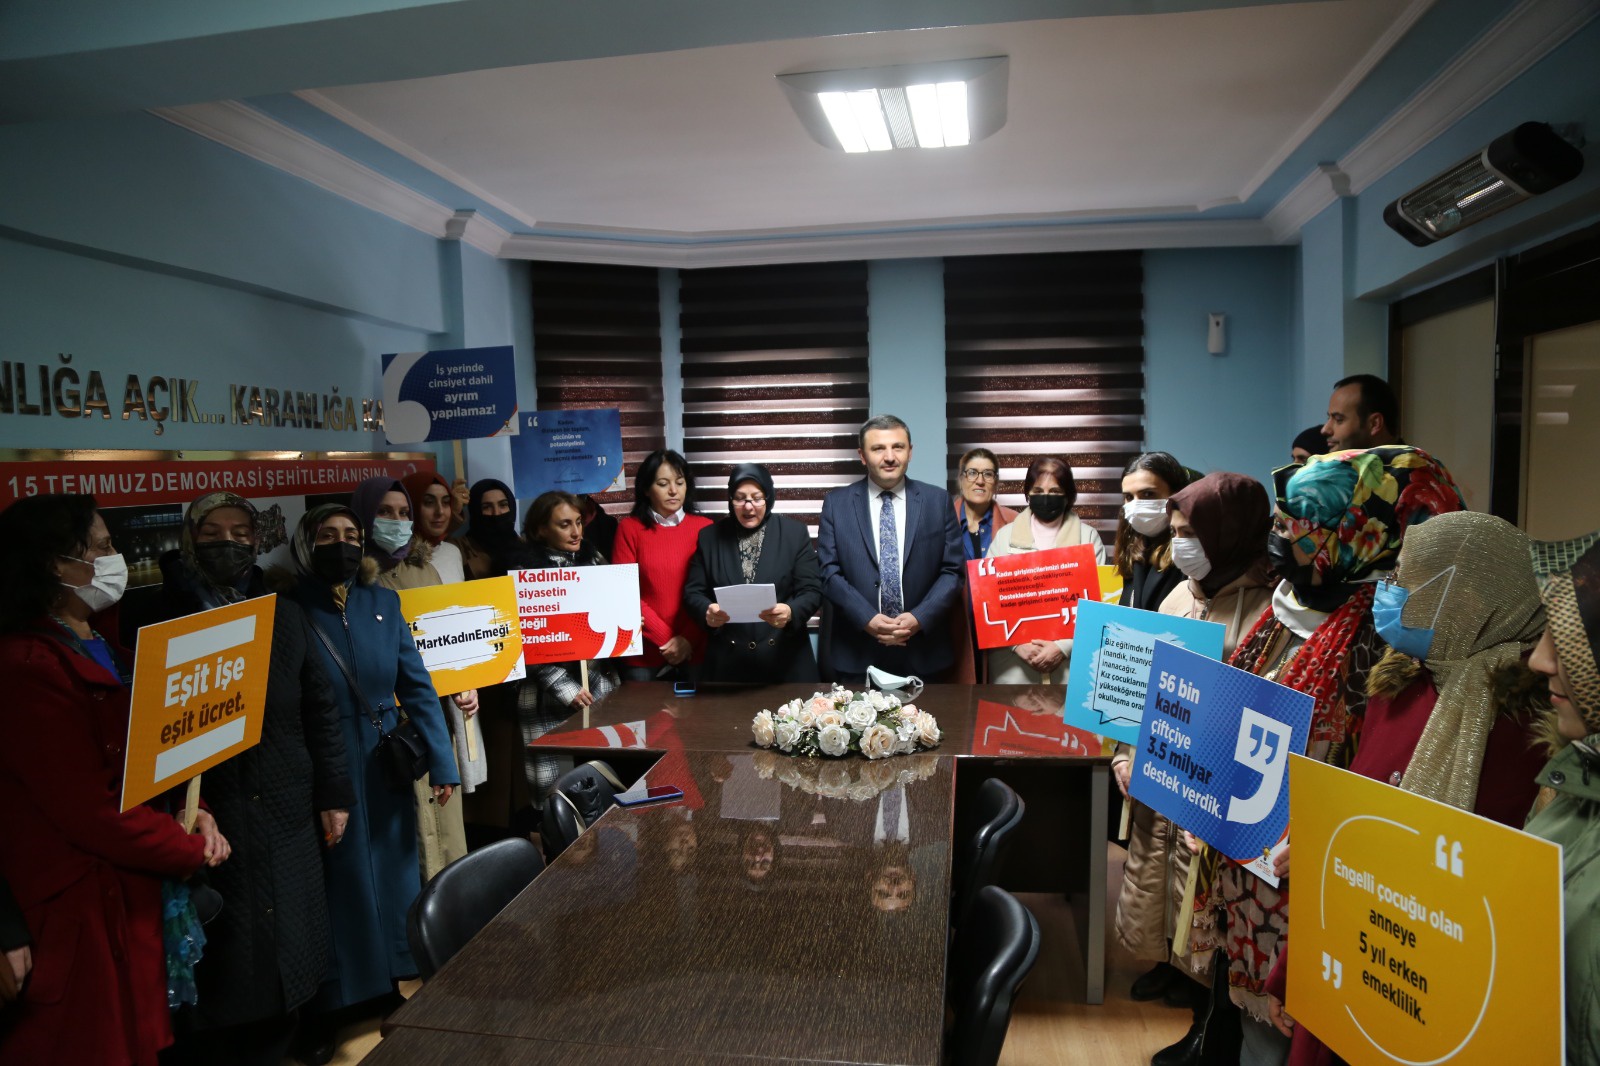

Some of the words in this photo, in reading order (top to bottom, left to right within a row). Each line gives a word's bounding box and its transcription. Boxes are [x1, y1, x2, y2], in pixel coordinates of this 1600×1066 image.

[436, 364, 445, 376] İş
[447, 363, 484, 375] yerinde
[428, 377, 466, 389] cinsiyet
[468, 375, 493, 385] dahil
[444, 392, 479, 404] ayrım
[229, 384, 358, 432] KARANLIĞA
[431, 404, 496, 420] yapılamaz!
[8, 476, 38, 498] 15
[44, 473, 148, 495] TEMMUZ
[152, 466, 262, 492] DEMOKRASİ
[266, 465, 339, 491] ŞEHİTLERİ
[518, 569, 580, 583] Kadınlar,
[1013, 564, 1060, 576] girişimcilerimizi
[519, 587, 567, 600] siyasetin
[999, 591, 1038, 601] Desteklerden
[1037, 587, 1069, 597] yararlanan
[519, 602, 560, 613] nesnesi
[1017, 598, 1043, 607] girişimci
[520, 617, 547, 630] değil
[521, 632, 573, 644] öznesidir.
[1104, 637, 1115, 647] Biz
[1115, 641, 1144, 653] eğitimde
[1103, 649, 1128, 662] inandık,
[1102, 659, 1137, 674] inanacağız.
[164, 663, 210, 708] Eşit
[214, 656, 245, 691] işe
[1101, 670, 1110, 679] Kız
[1158, 671, 1176, 693] 56
[1177, 678, 1200, 705] bin
[1098, 692, 1130, 707] okullaşma
[1155, 692, 1191, 724] kadın
[160, 711, 194, 744] eşit
[198, 691, 245, 729] ücret.
[1151, 719, 1192, 750] çiftçiye
[1147, 736, 1168, 761] 3.5
[1168, 750, 1213, 785] milyar
[1143, 761, 1179, 795] destek
[1182, 784, 1222, 820] verdik.
[1334, 857, 1375, 894] Engelli
[1377, 883, 1427, 922] çocuğu
[1429, 910, 1463, 943] olan
[1369, 909, 1416, 948] anneye
[1359, 931, 1367, 954] 5
[1371, 943, 1386, 967] yıl
[1389, 957, 1427, 994] erken
[1362, 969, 1426, 1026] emeklilik.
